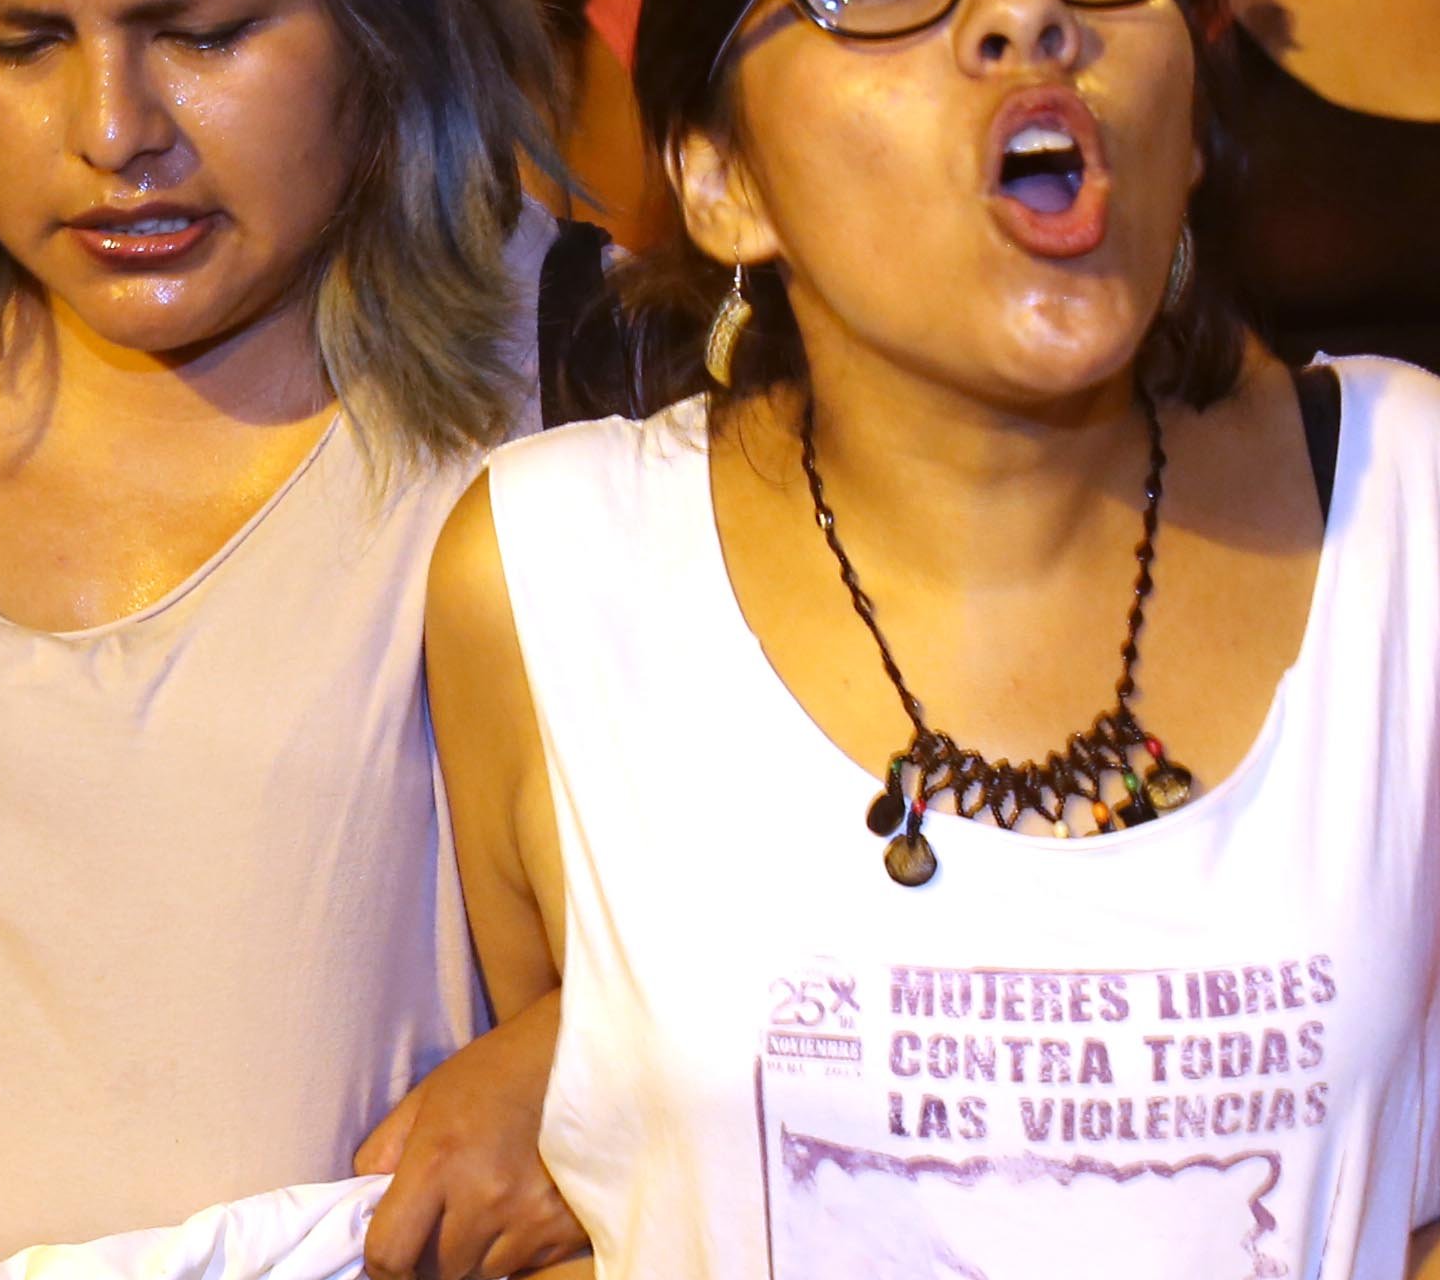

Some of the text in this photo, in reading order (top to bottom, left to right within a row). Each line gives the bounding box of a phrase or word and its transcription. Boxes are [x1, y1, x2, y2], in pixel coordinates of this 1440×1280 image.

[889, 955, 1337, 1022] MUJERES LIBRES
[889, 1021, 1325, 1084] CONTRA TODAS
[888, 1082, 1328, 1142] LAS VIOLENCIAS
